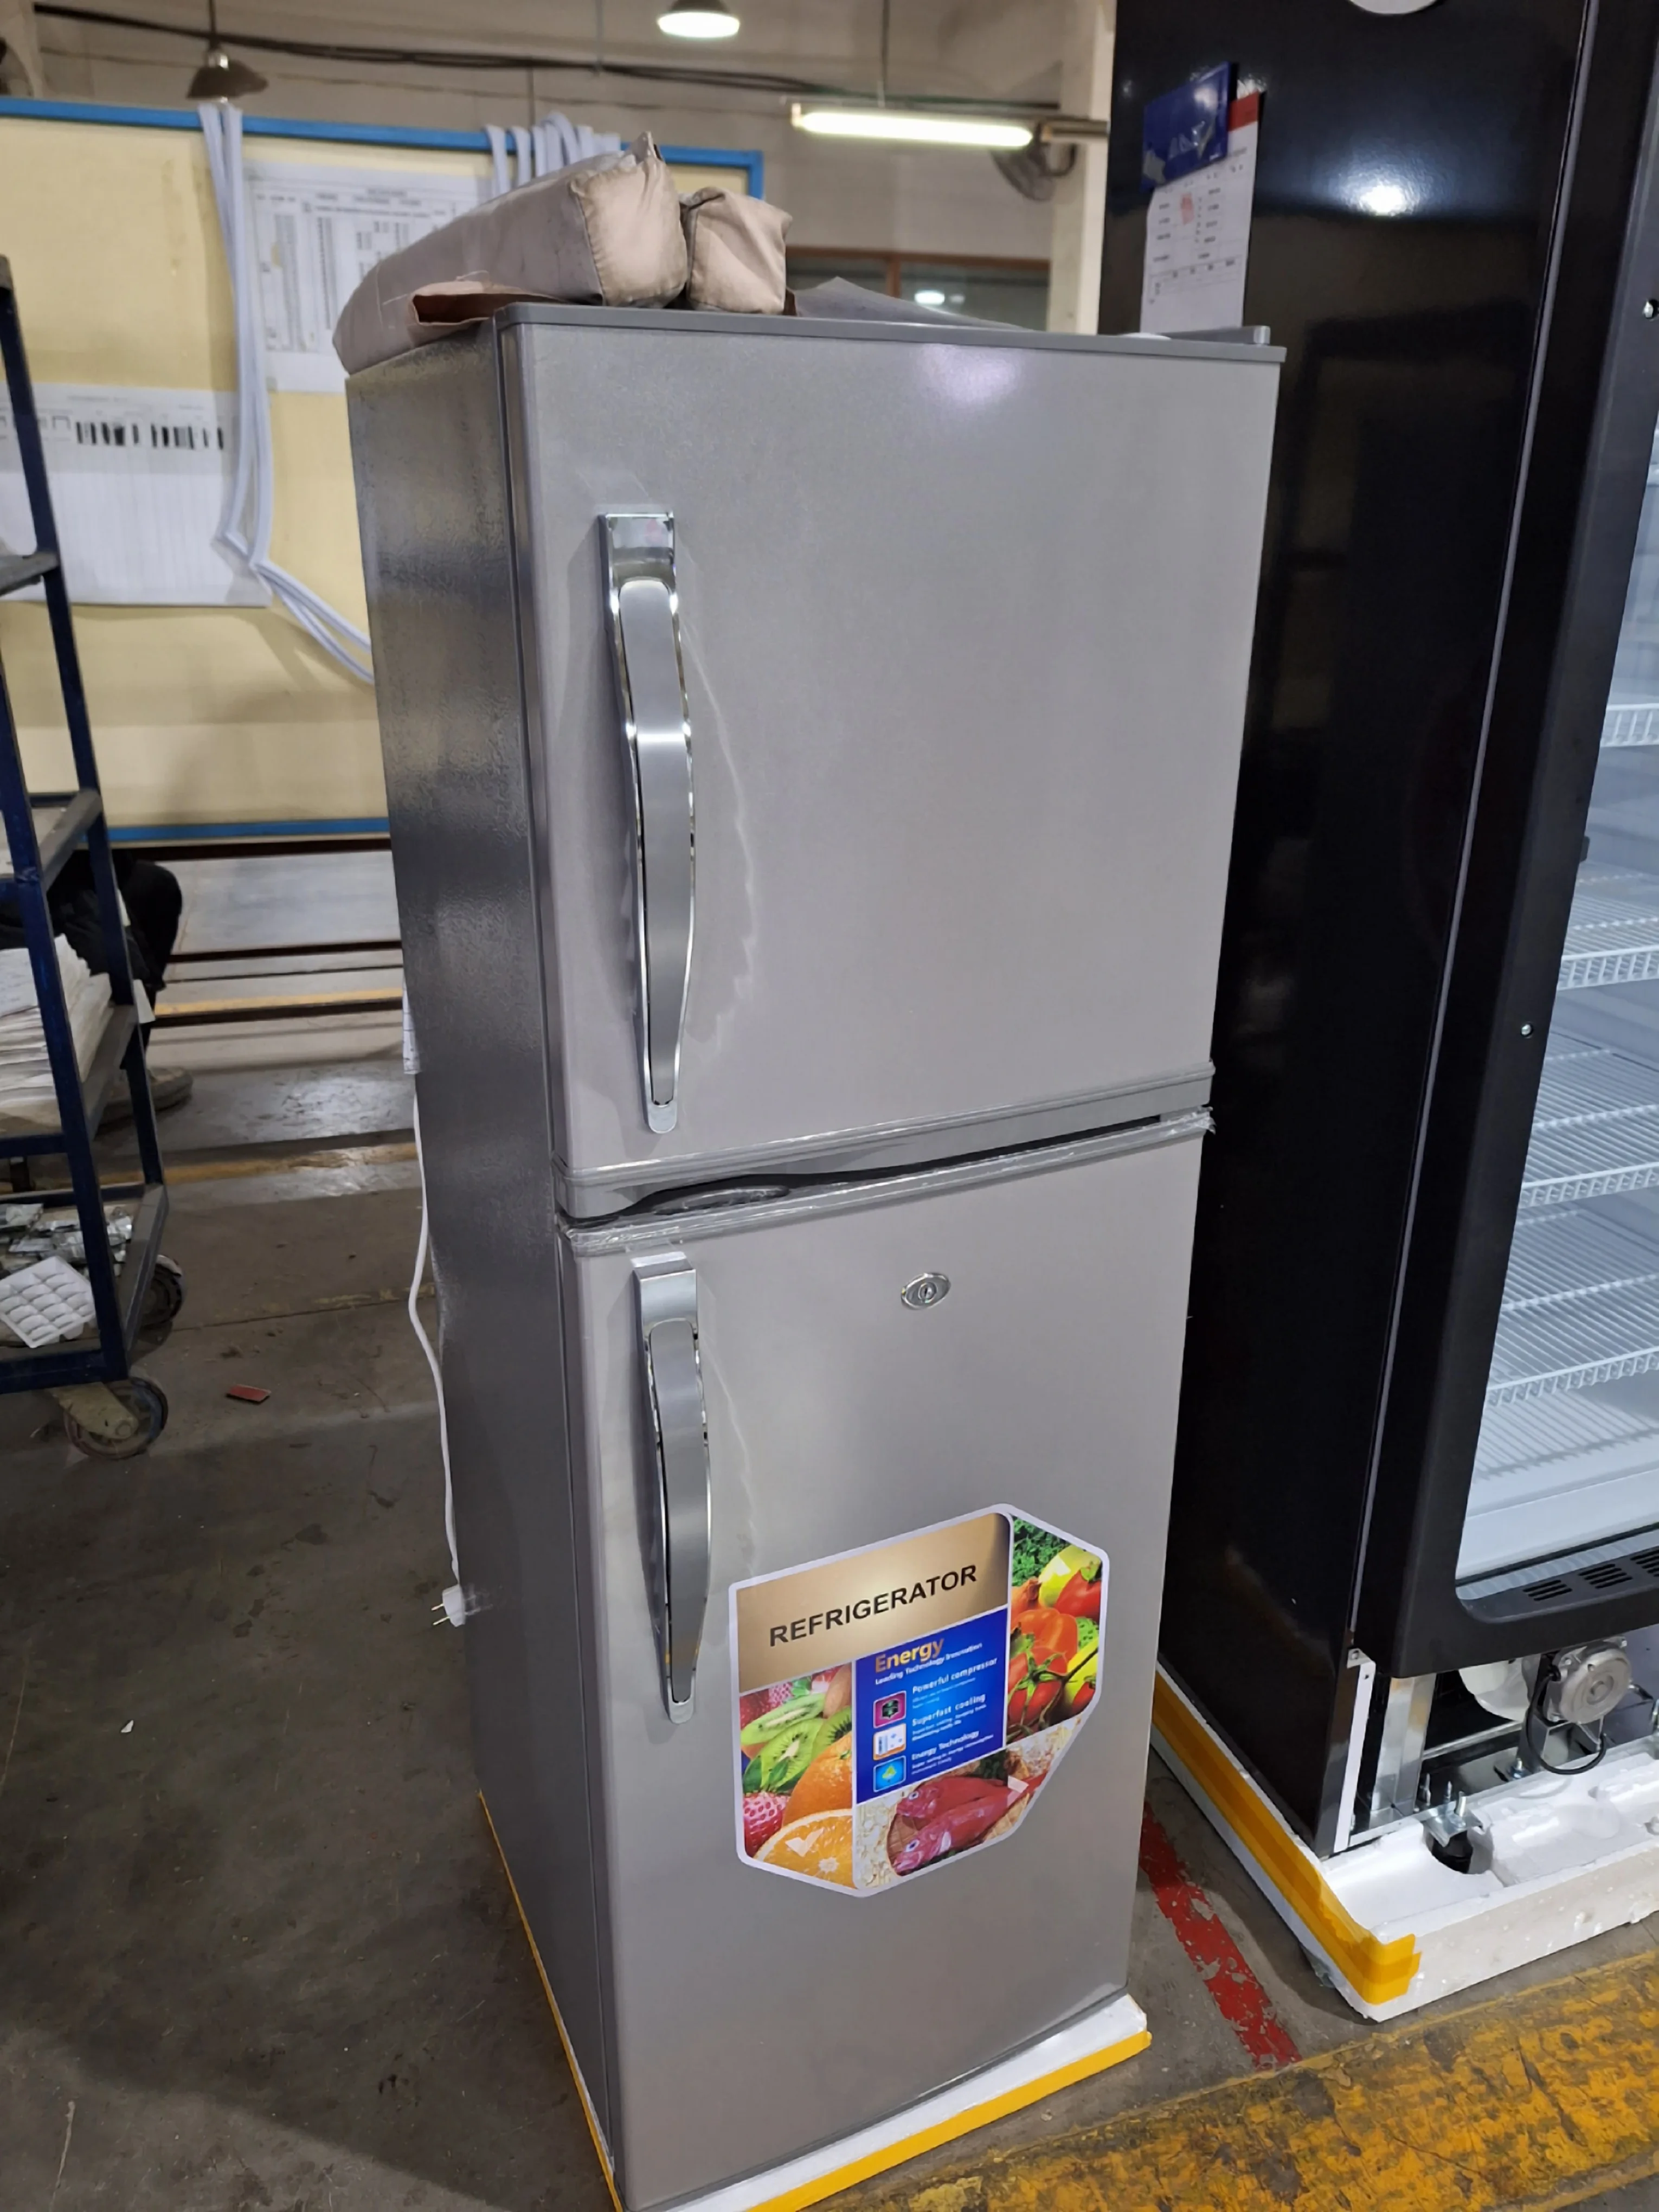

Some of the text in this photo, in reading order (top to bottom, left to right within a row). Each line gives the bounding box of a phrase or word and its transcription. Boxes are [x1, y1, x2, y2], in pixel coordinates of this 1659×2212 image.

[770, 1565, 977, 1647] REFRIGERATOR
[875, 1638, 944, 1673] Energy
[875, 1671, 903, 1685] Leading
[905, 1657, 945, 1675] Technology
[912, 1674, 949, 1694] Powerful
[951, 1658, 998, 1680] compressor
[912, 1706, 951, 1726] Superfast
[955, 1694, 986, 1711] cooling
[911, 1747, 937, 1760] Energy
